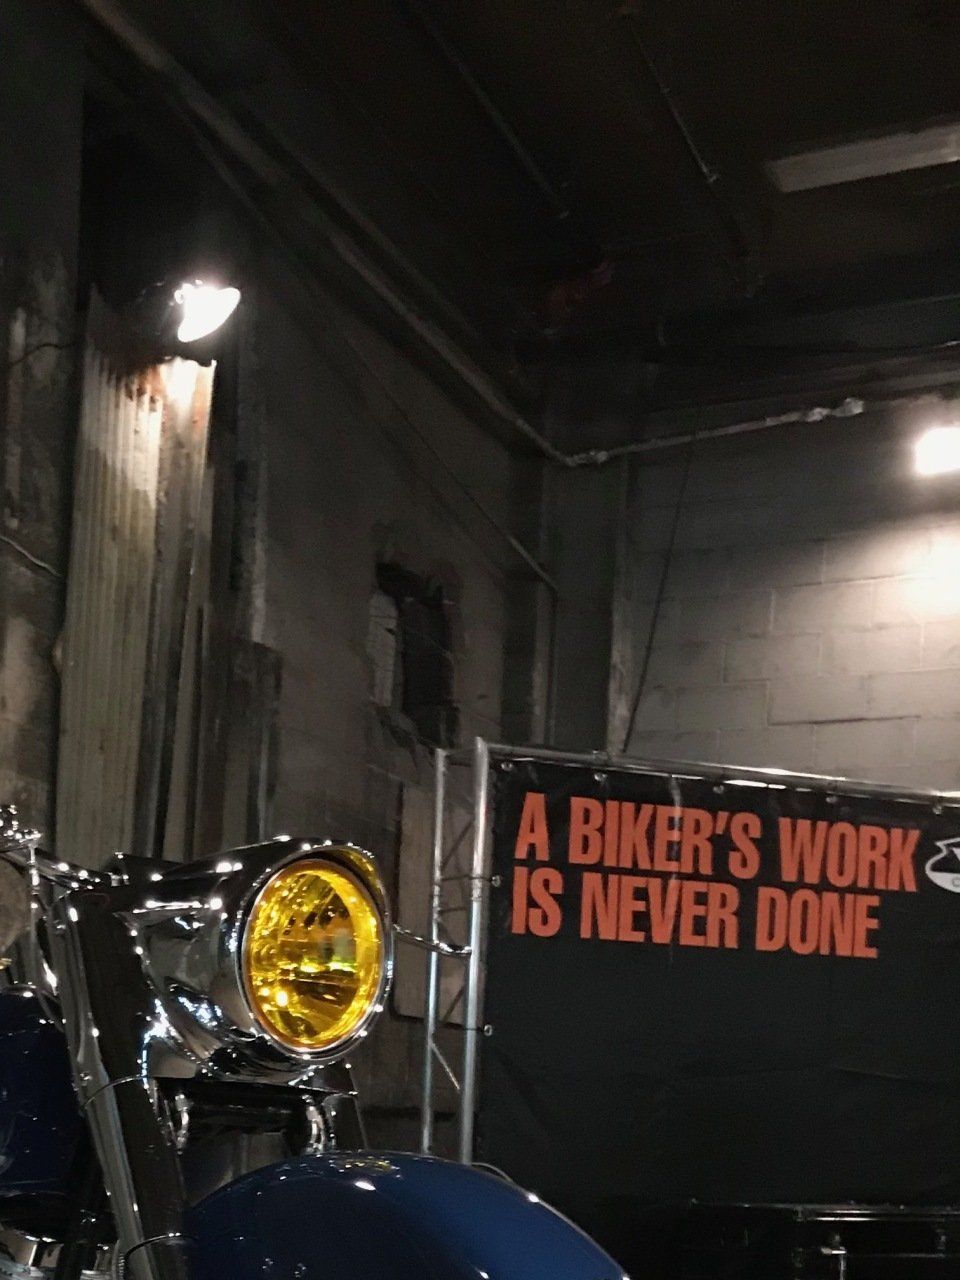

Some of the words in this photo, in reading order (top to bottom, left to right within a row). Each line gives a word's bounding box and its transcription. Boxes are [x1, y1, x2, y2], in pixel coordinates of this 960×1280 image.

[515, 792, 550, 861] A
[568, 796, 761, 879] BIKER'S
[778, 817, 921, 892] WORK
[511, 866, 563, 937] IS
[580, 871, 738, 949] NEVER
[755, 887, 880, 958] DONE
